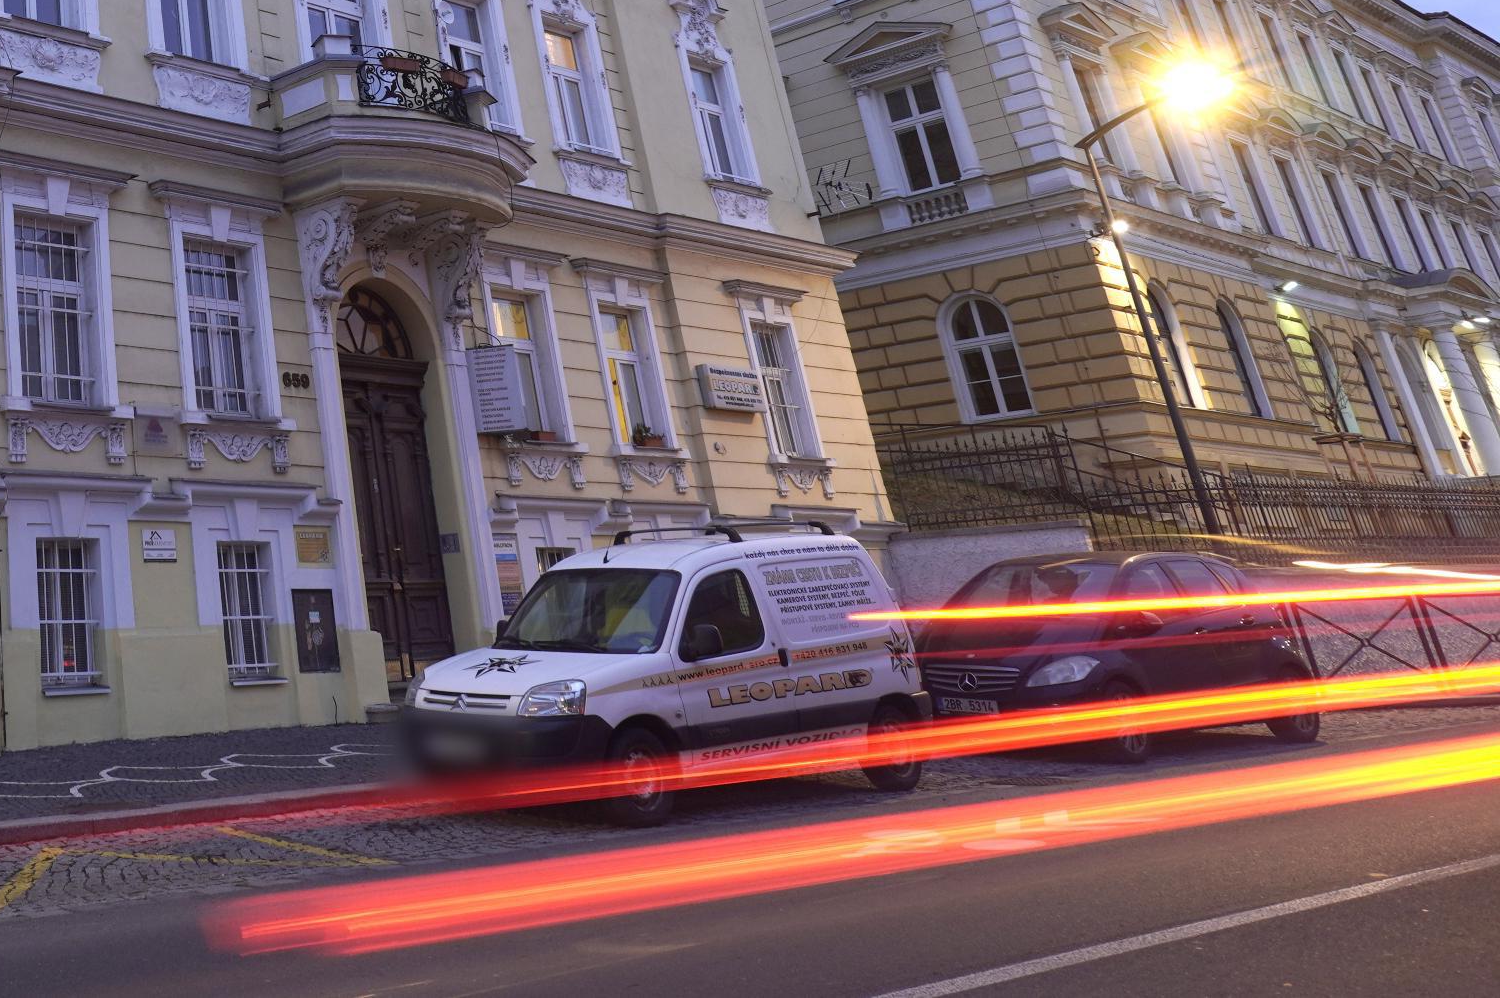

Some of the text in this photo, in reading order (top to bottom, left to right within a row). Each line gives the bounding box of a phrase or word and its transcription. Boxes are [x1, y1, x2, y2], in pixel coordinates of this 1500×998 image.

[836, 644, 851, 654] 831
[707, 668, 873, 708] LEOPARD
[701, 728, 863, 761] SERVISNÍ VOZIDLO
